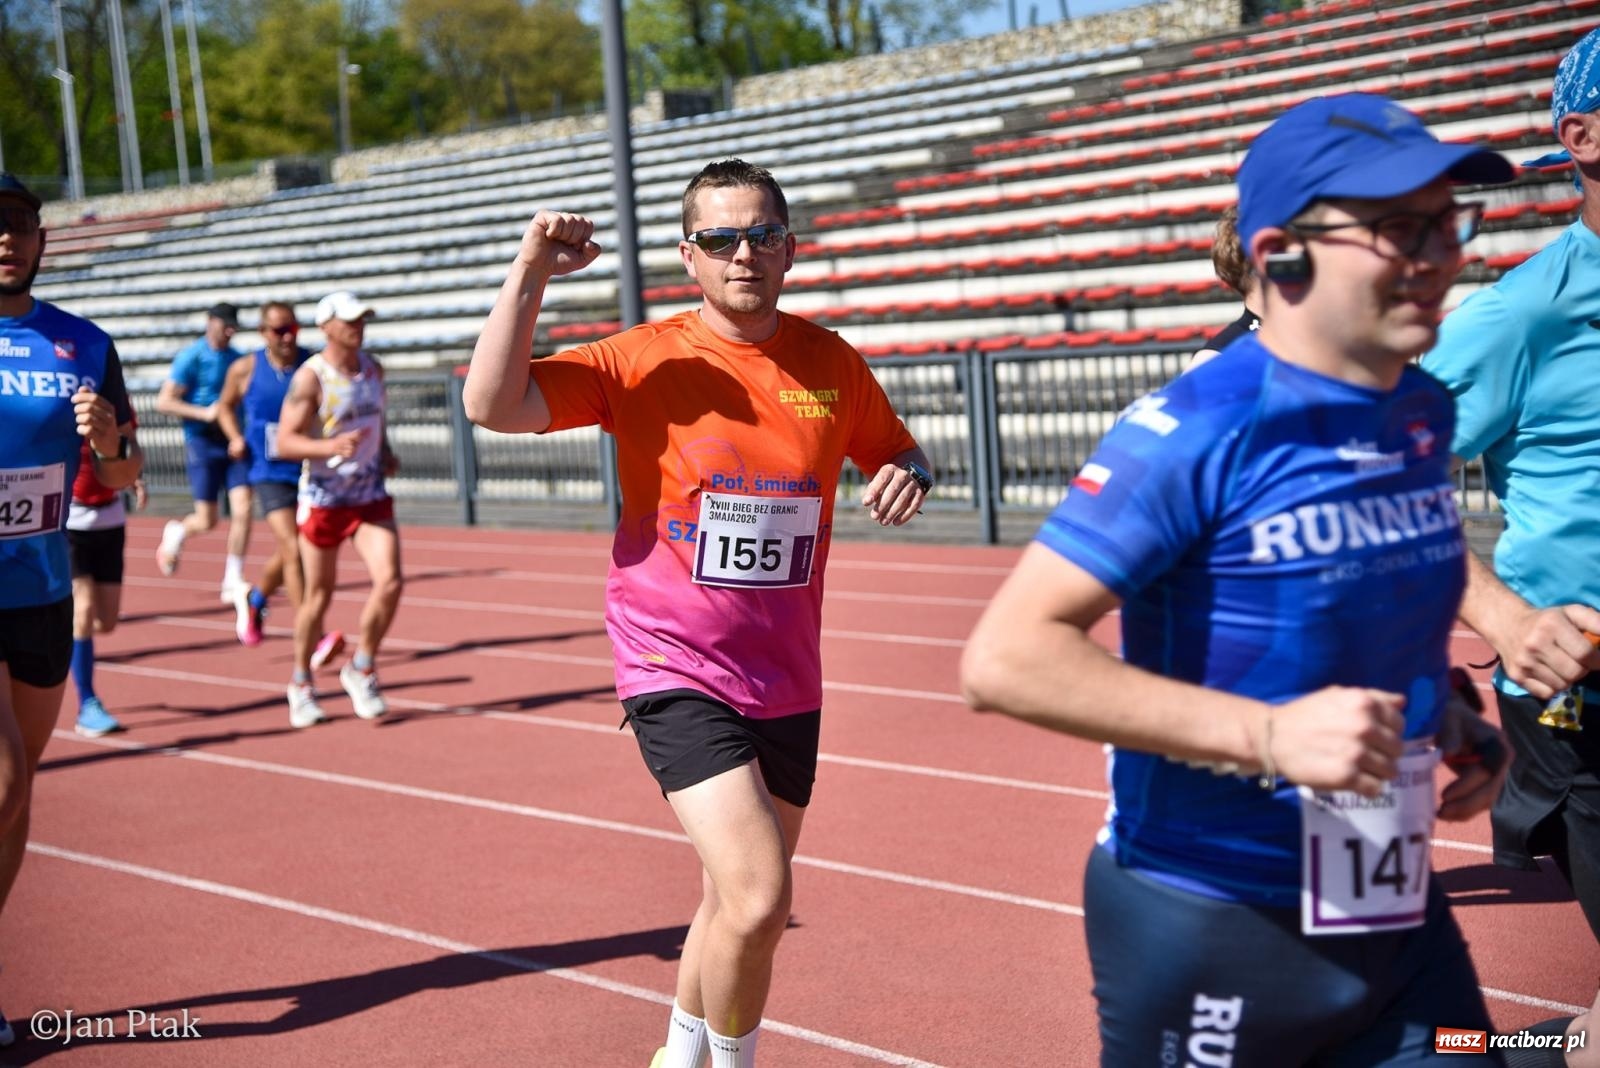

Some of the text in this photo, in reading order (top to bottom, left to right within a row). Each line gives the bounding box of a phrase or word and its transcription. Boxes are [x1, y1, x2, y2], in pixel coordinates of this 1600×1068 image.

[778, 388, 839, 403] SZWAGRY
[795, 405, 832, 418] TEAM
[712, 474, 818, 493] Pot, śmiech
[710, 500, 799, 515] XVIII BIEG BEZ GRANIC
[709, 511, 757, 524] 3MAJA2026
[718, 535, 782, 572] 155
[1344, 832, 1425, 900] 147
